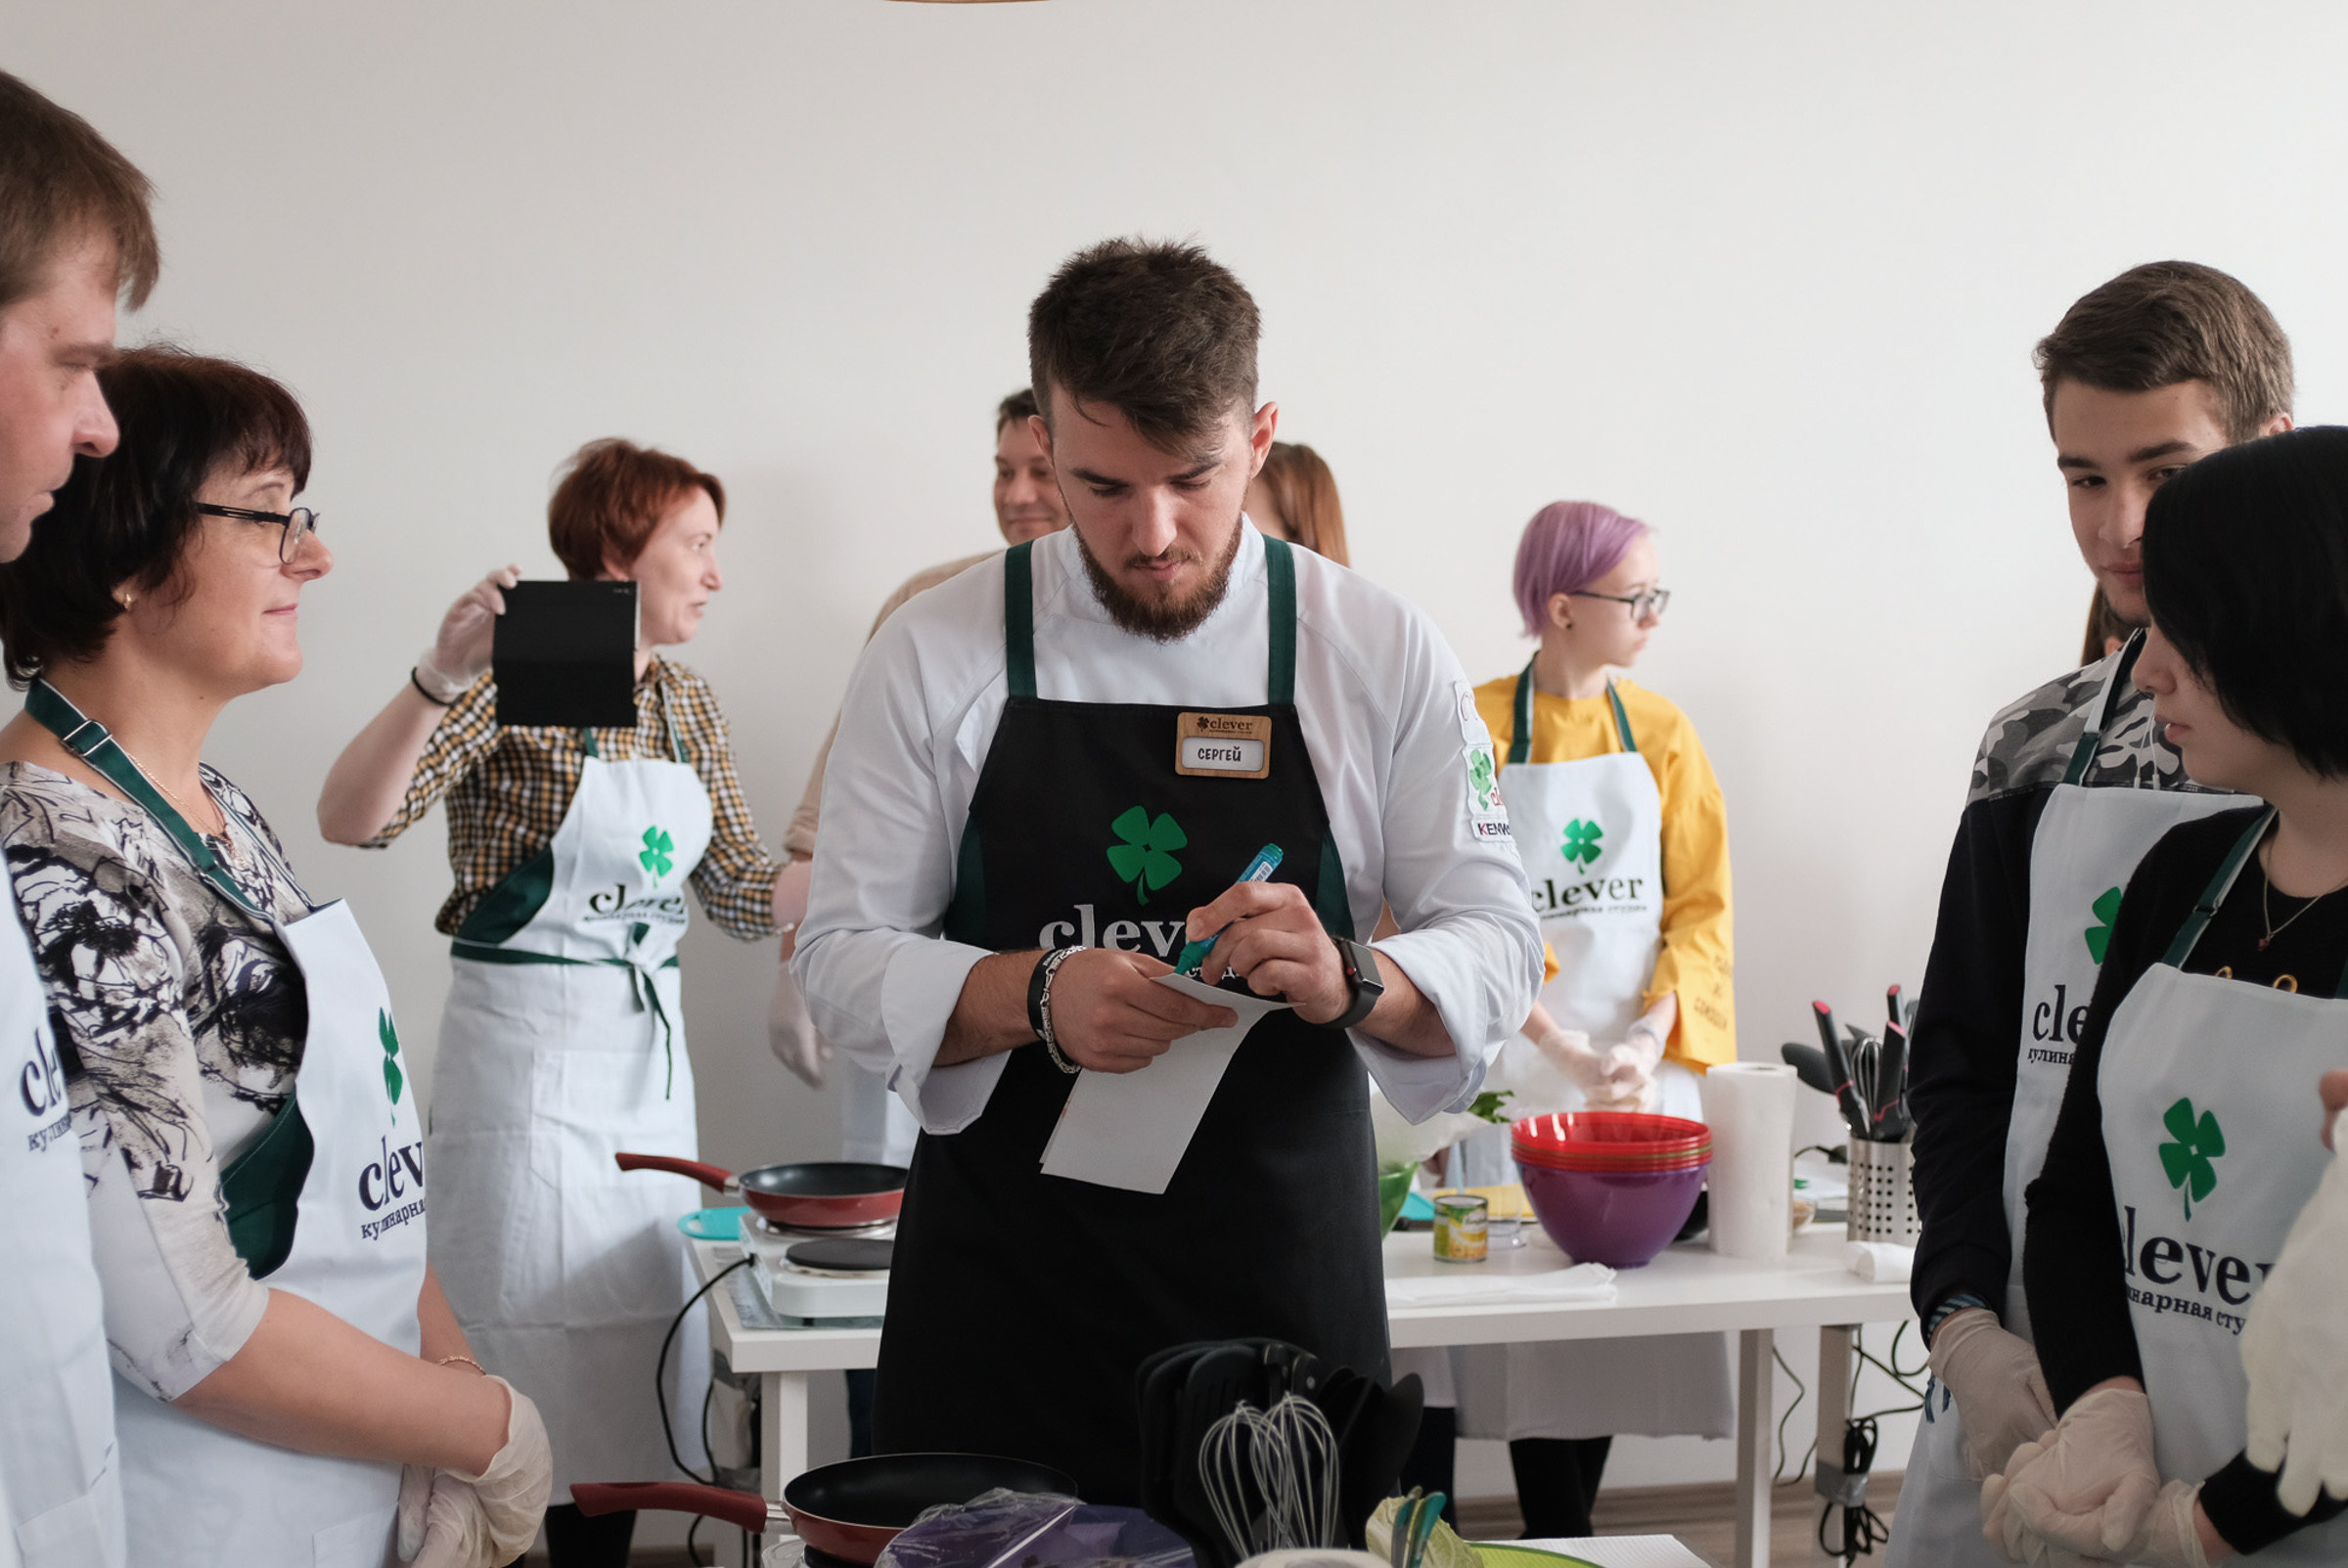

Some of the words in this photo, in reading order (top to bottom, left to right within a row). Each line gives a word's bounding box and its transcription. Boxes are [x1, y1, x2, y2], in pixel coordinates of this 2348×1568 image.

[1209, 717, 1253, 731] clever
[1197, 746, 1242, 762] СЕРГЕЙ
[1039, 904, 1188, 958] clev
[2121, 1205, 2275, 1306] leve
